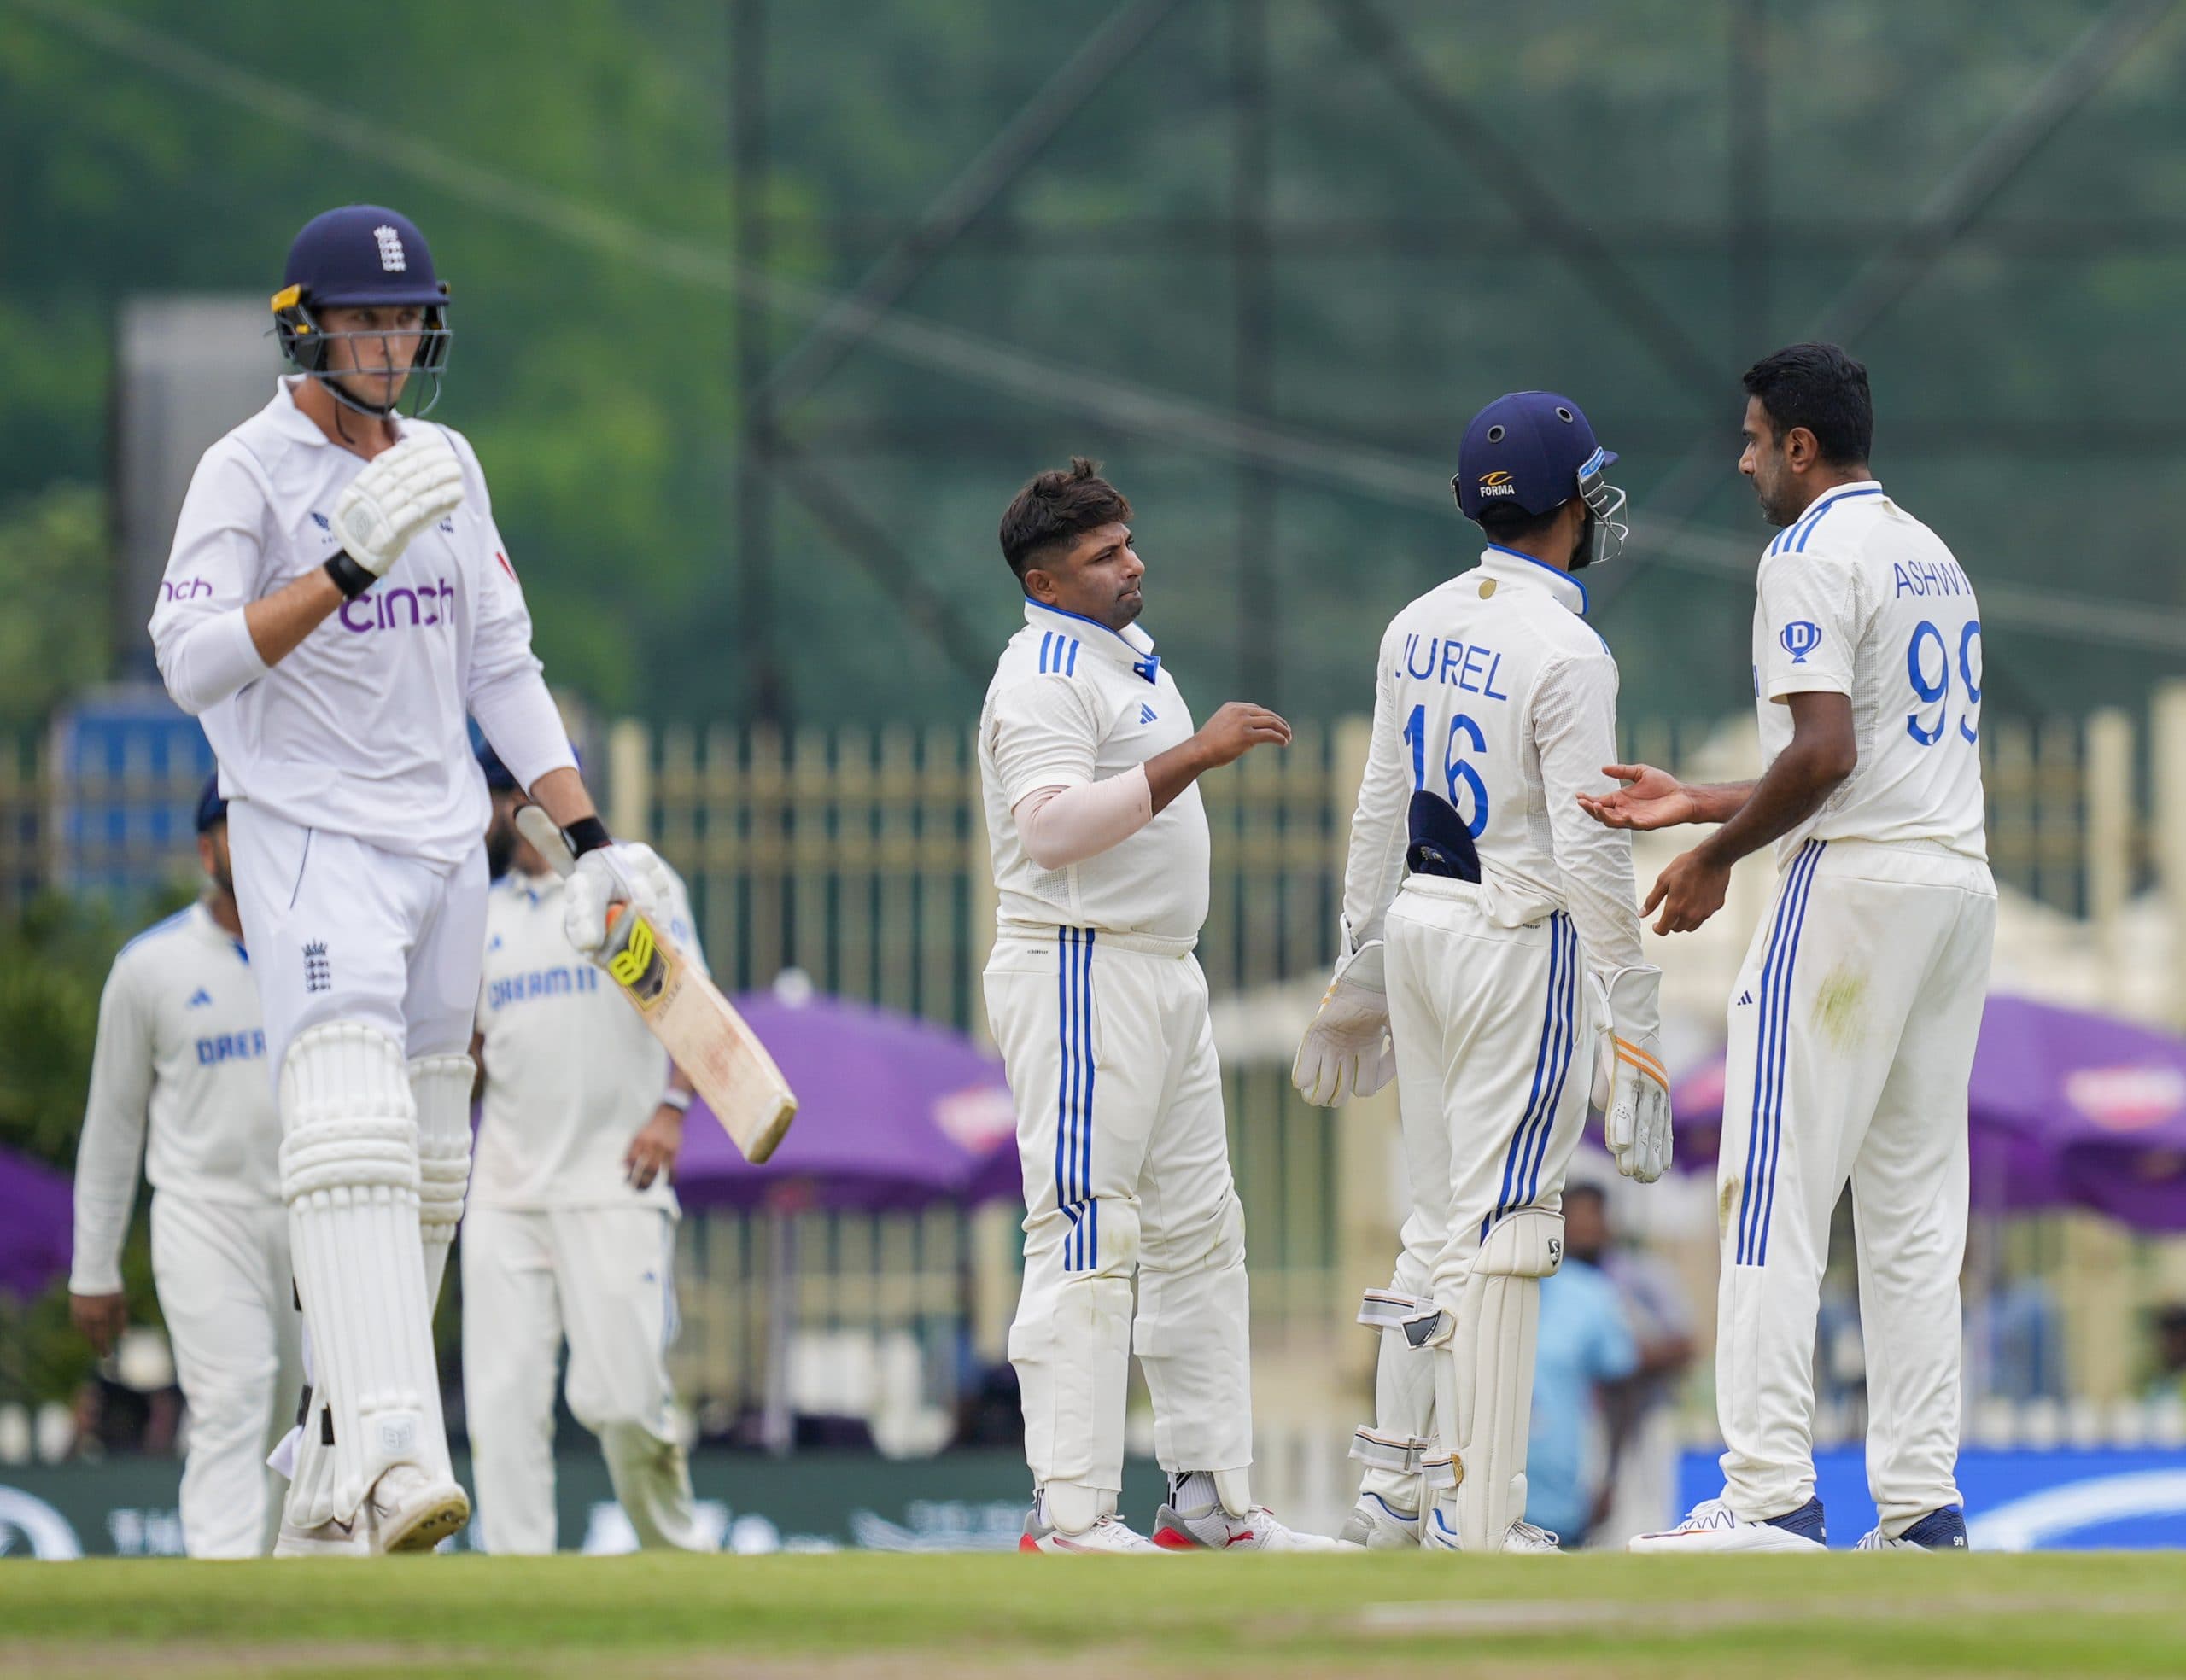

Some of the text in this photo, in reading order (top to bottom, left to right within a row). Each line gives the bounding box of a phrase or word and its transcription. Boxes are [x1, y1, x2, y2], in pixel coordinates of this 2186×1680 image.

[1479, 484, 1516, 498] FORMA
[339, 577, 454, 633] cinch
[1395, 633, 1507, 702] JUREL
[1907, 620, 1982, 746] 99
[1403, 703, 1489, 839] 16
[1953, 1535, 1964, 1547] 99
